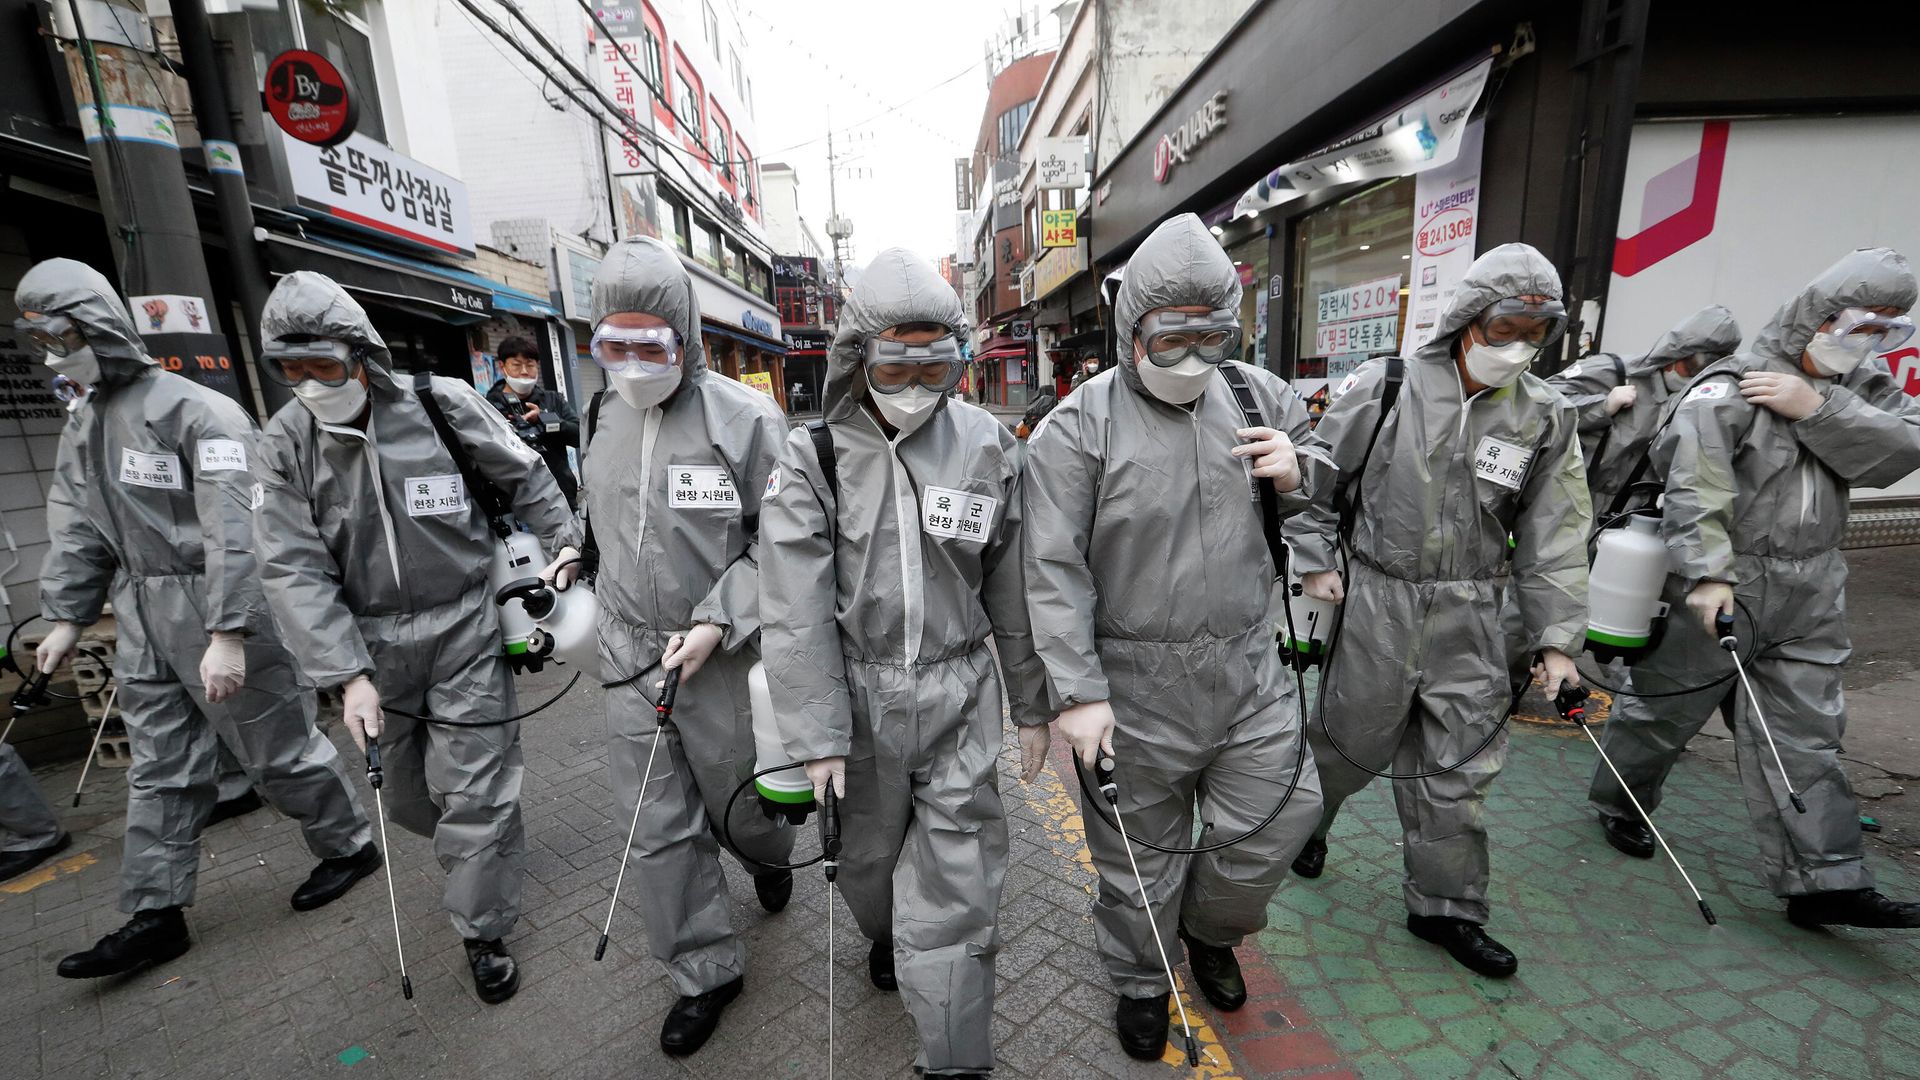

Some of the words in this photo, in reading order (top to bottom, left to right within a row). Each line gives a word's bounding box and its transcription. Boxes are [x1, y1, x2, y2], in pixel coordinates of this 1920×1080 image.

[603, 43, 639, 63] 코인
[1168, 90, 1229, 165] SQUARE
[319, 145, 455, 235] 솥뚜껑삼겹살
[1045, 212, 1075, 228] 야구
[1045, 228, 1075, 244] 사격
[32, 408, 63, 418] STYLE
[1486, 445, 1502, 461] 육
[155, 460, 169, 473] 군
[1475, 458, 1498, 474] 현장
[1499, 467, 1521, 482] 지원
[143, 472, 174, 484] 지원팀
[679, 472, 694, 487] 육
[416, 483, 430, 496] 육
[675, 489, 698, 502] 현장
[702, 489, 735, 502] 지원팀
[414, 498, 436, 510] 현장
[935, 496, 952, 513] 육
[970, 502, 984, 519] 군
[928, 513, 954, 530] 현장
[956, 519, 983, 535] 지원팀
